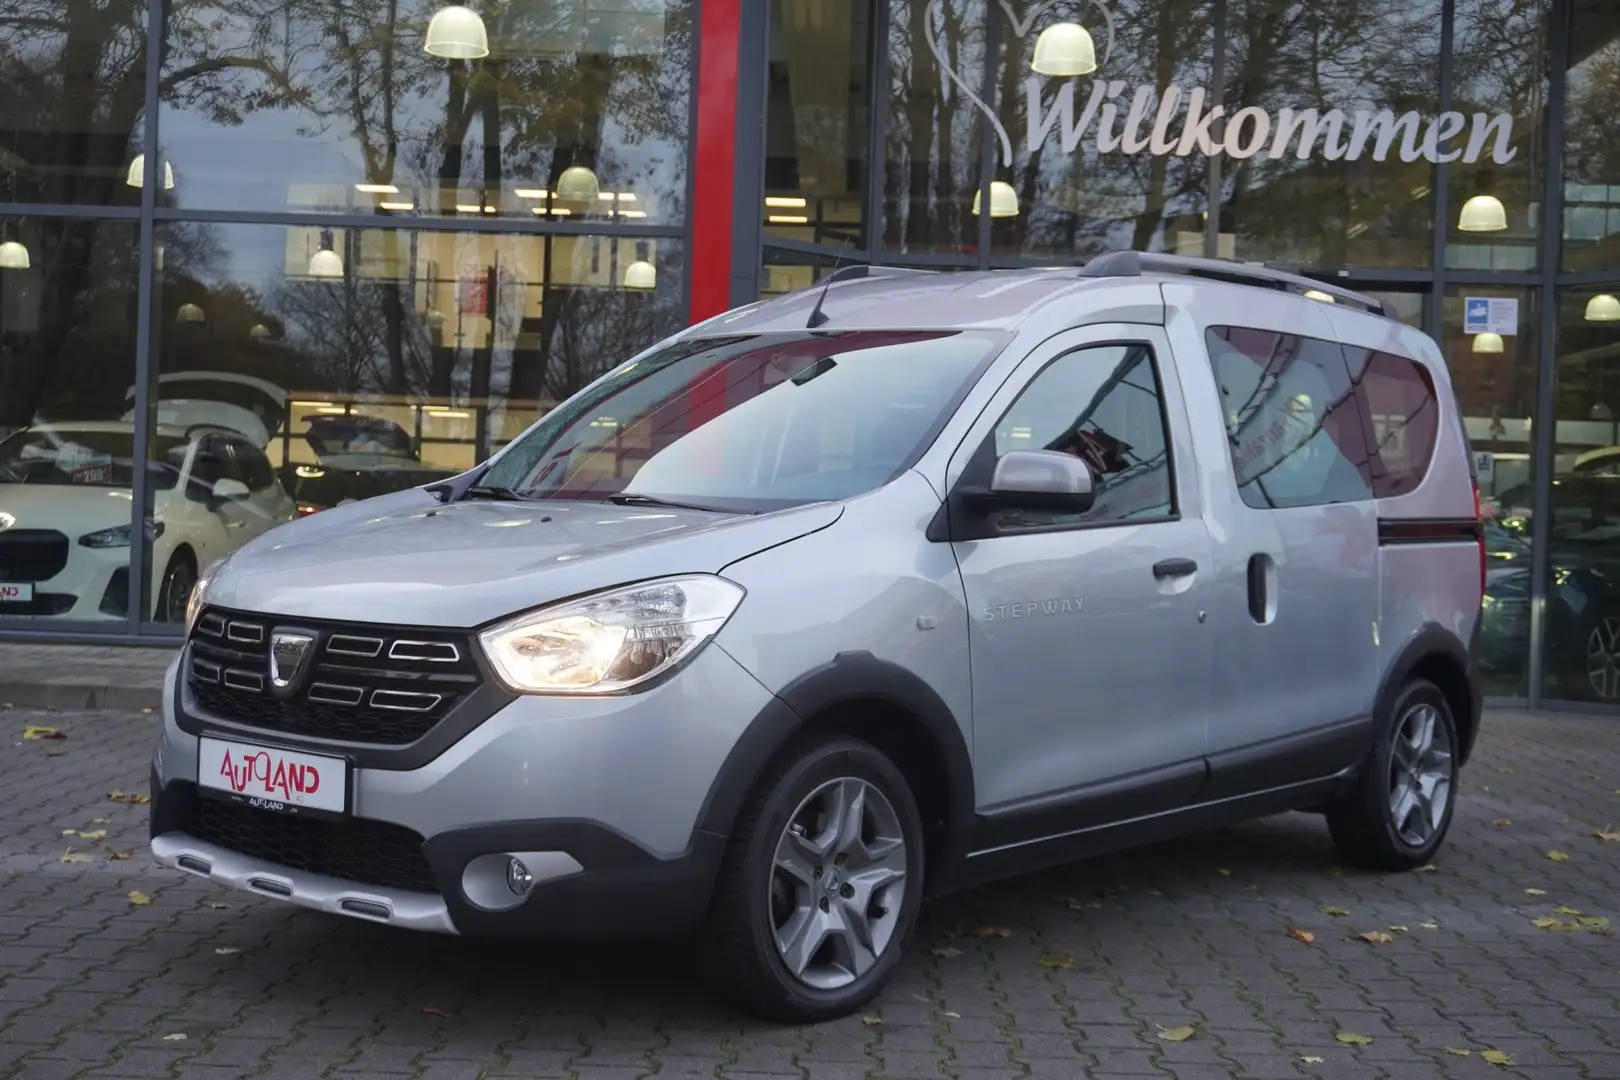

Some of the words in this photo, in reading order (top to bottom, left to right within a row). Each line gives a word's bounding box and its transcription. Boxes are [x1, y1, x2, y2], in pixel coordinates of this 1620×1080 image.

[1026, 78, 1518, 164] Willkommen
[983, 597, 1084, 622] STEPWAY
[220, 748, 320, 800] AUTOLAND
